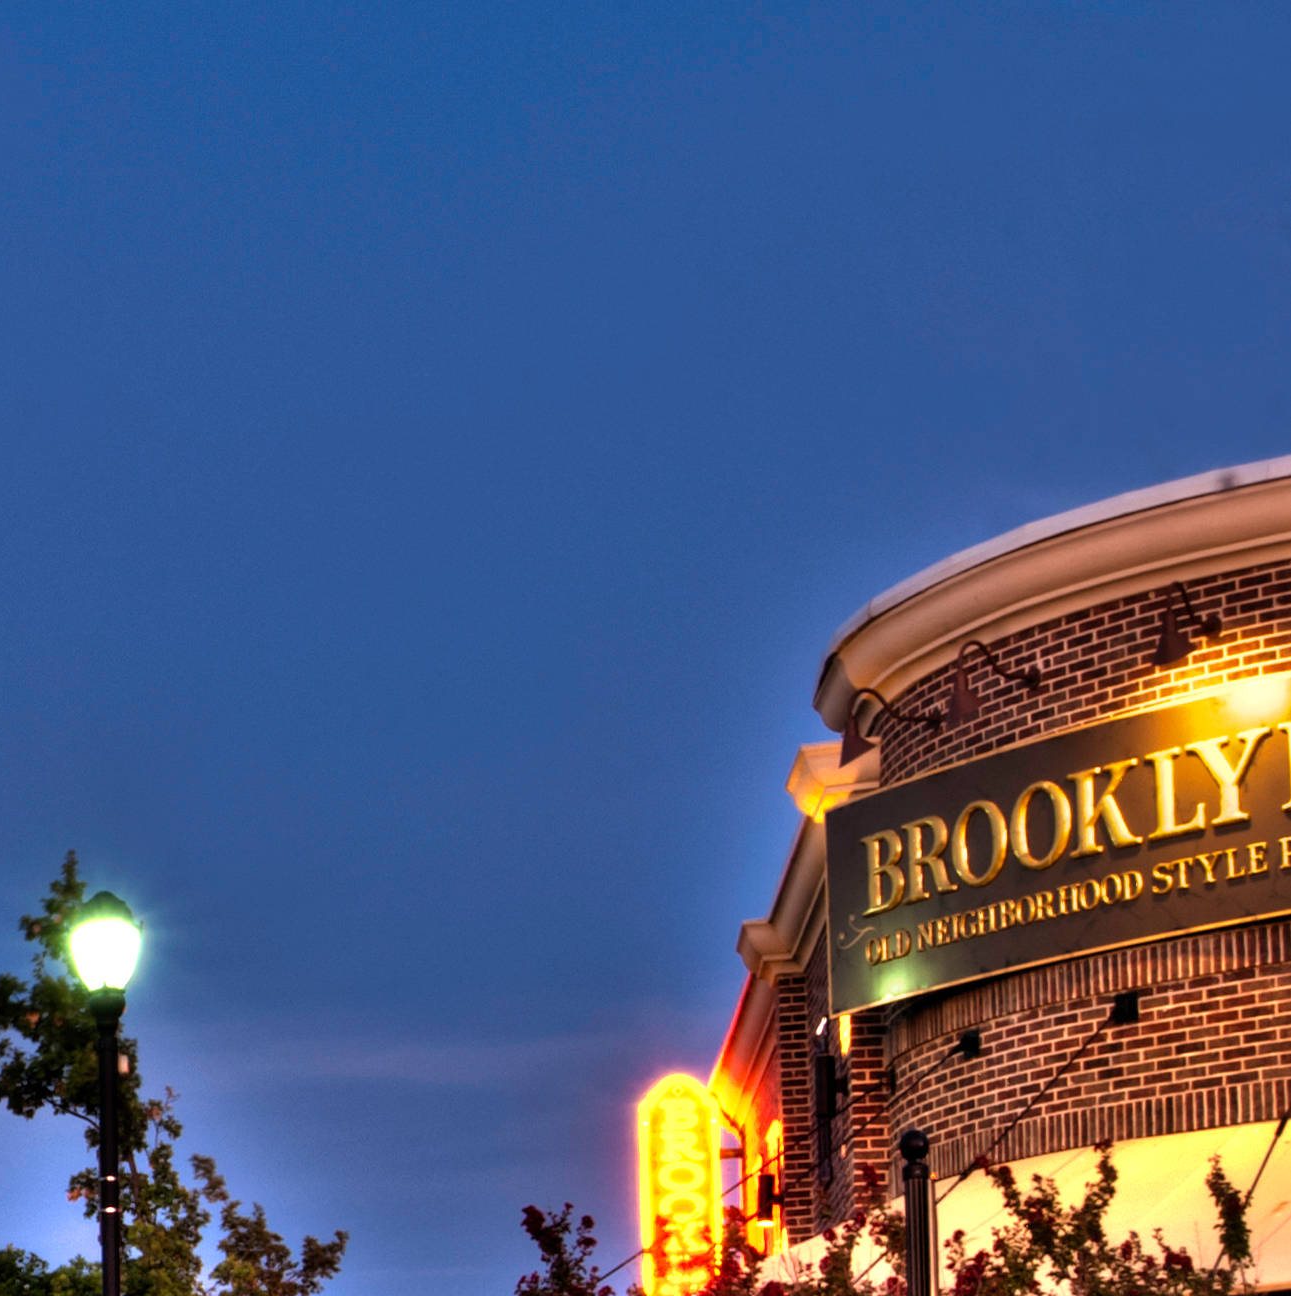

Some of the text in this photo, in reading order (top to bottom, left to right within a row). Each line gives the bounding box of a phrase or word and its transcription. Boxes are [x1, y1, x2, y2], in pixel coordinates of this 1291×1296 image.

[865, 928, 912, 966] OLD
[918, 870, 1144, 951] NEIGHBORHOOD
[1152, 841, 1268, 894] STYLE
